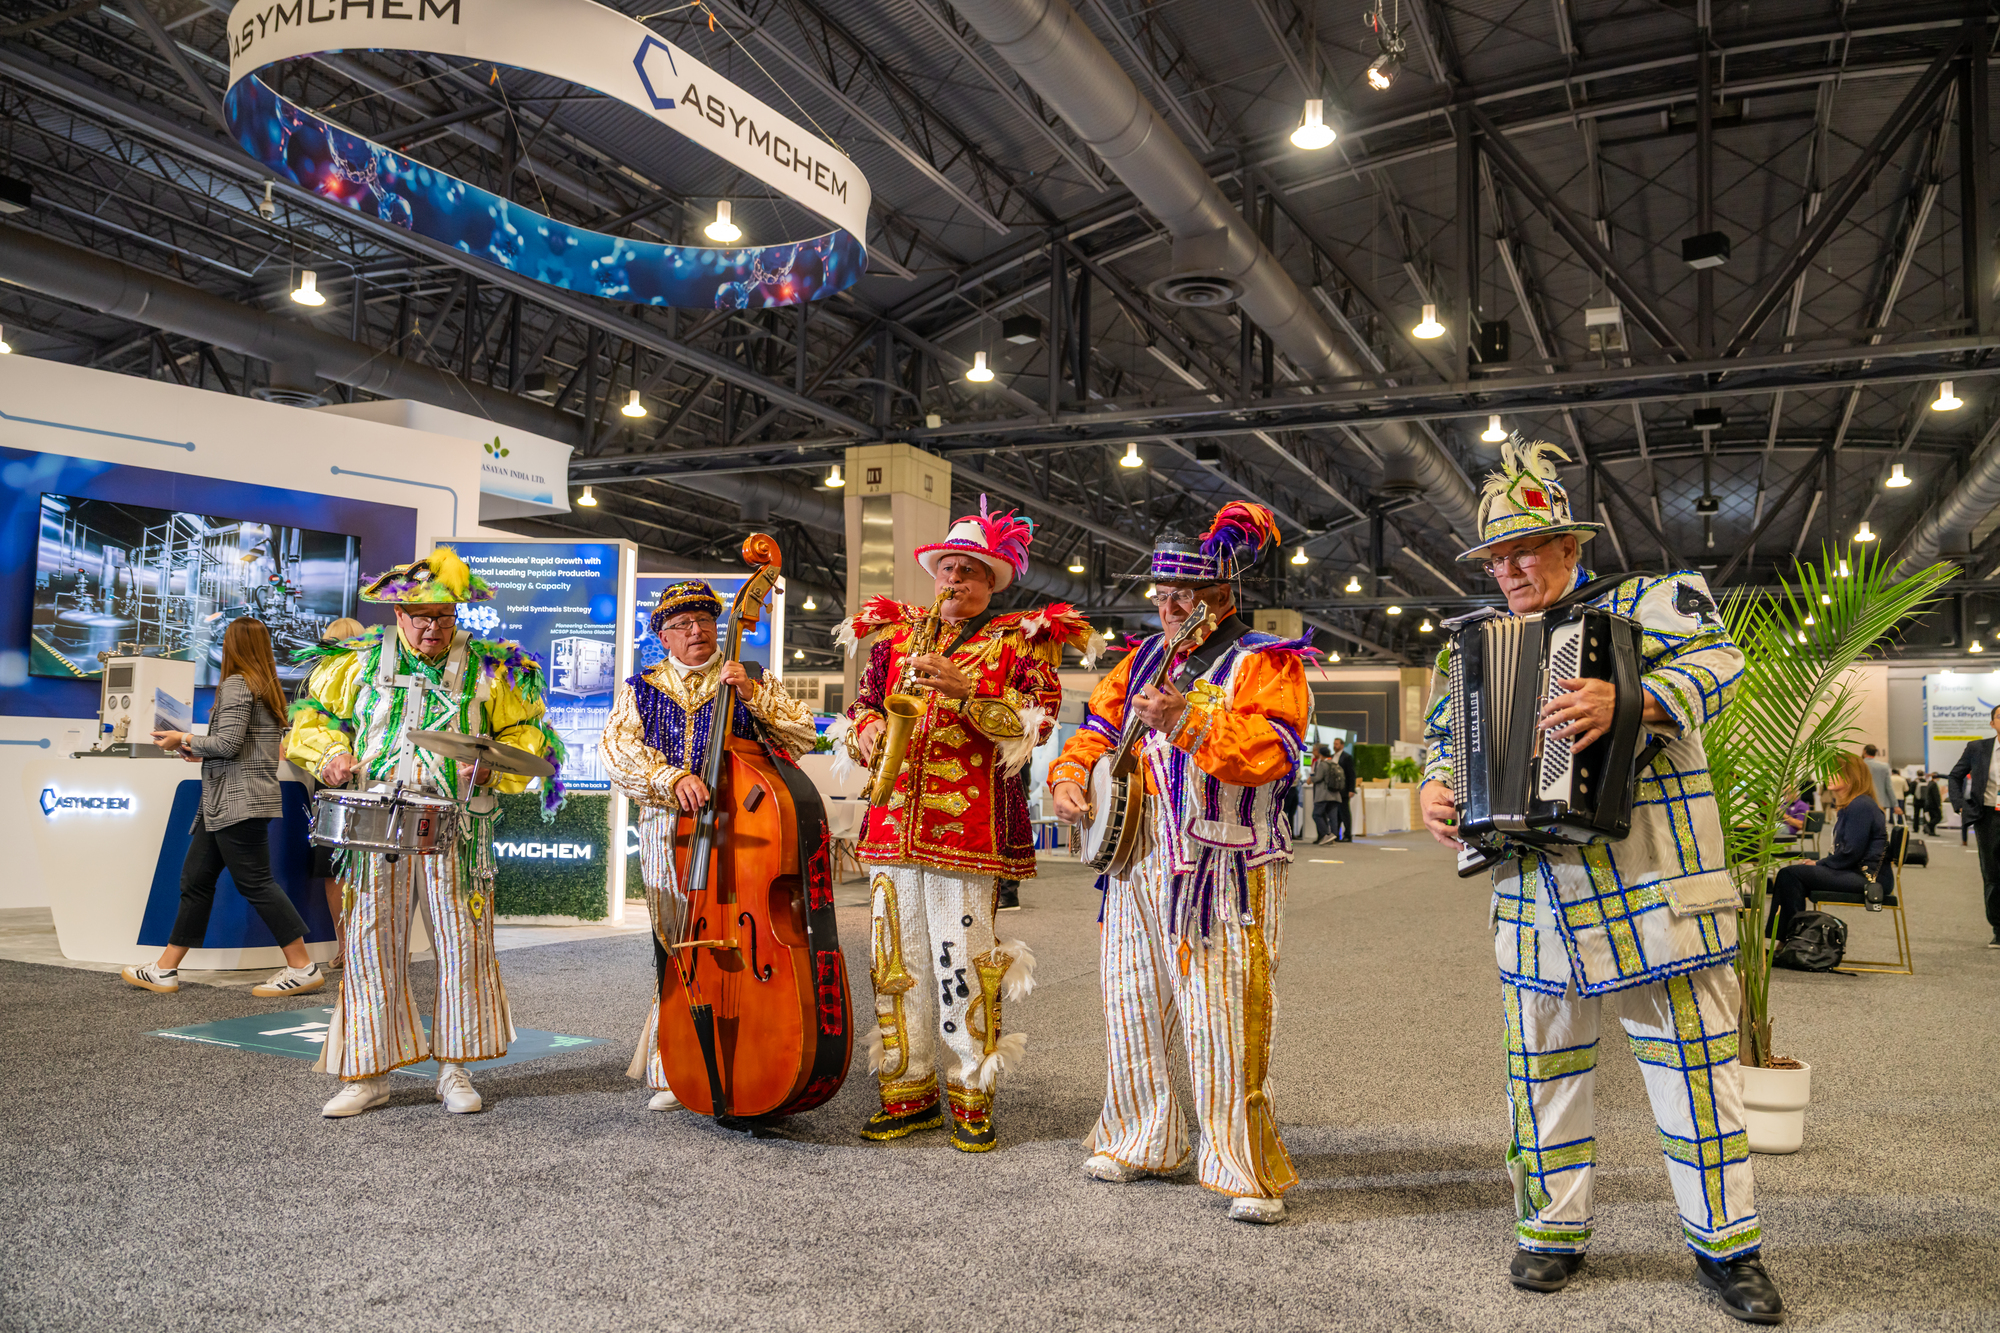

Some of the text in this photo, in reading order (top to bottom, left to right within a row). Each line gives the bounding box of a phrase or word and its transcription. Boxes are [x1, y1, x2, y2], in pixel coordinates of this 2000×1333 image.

[232, 0, 460, 60] ASYMCHEM
[680, 83, 848, 204] ASYMCHEM
[481, 463, 508, 476] ASAYAN
[510, 470, 529, 481] INDIA
[490, 556, 530, 564] Molecules'
[531, 556, 553, 566] Rapid
[584, 557, 601, 565] with
[495, 568, 526, 578] Leading
[527, 569, 557, 578] Peptide
[558, 569, 600, 577] Production
[487, 581, 526, 591] echnology
[535, 582, 571, 591] Capacity
[507, 605, 592, 614] Hybrid Synthesis Strategy
[566, 706, 586, 714] Chain
[587, 706, 610, 715] Supply
[1932, 704, 1976, 712] Restoring
[1470, 691, 1480, 752] EXCELSIOR
[54, 796, 130, 810] ASYMCHEM
[494, 842, 591, 859] YMCHEM
